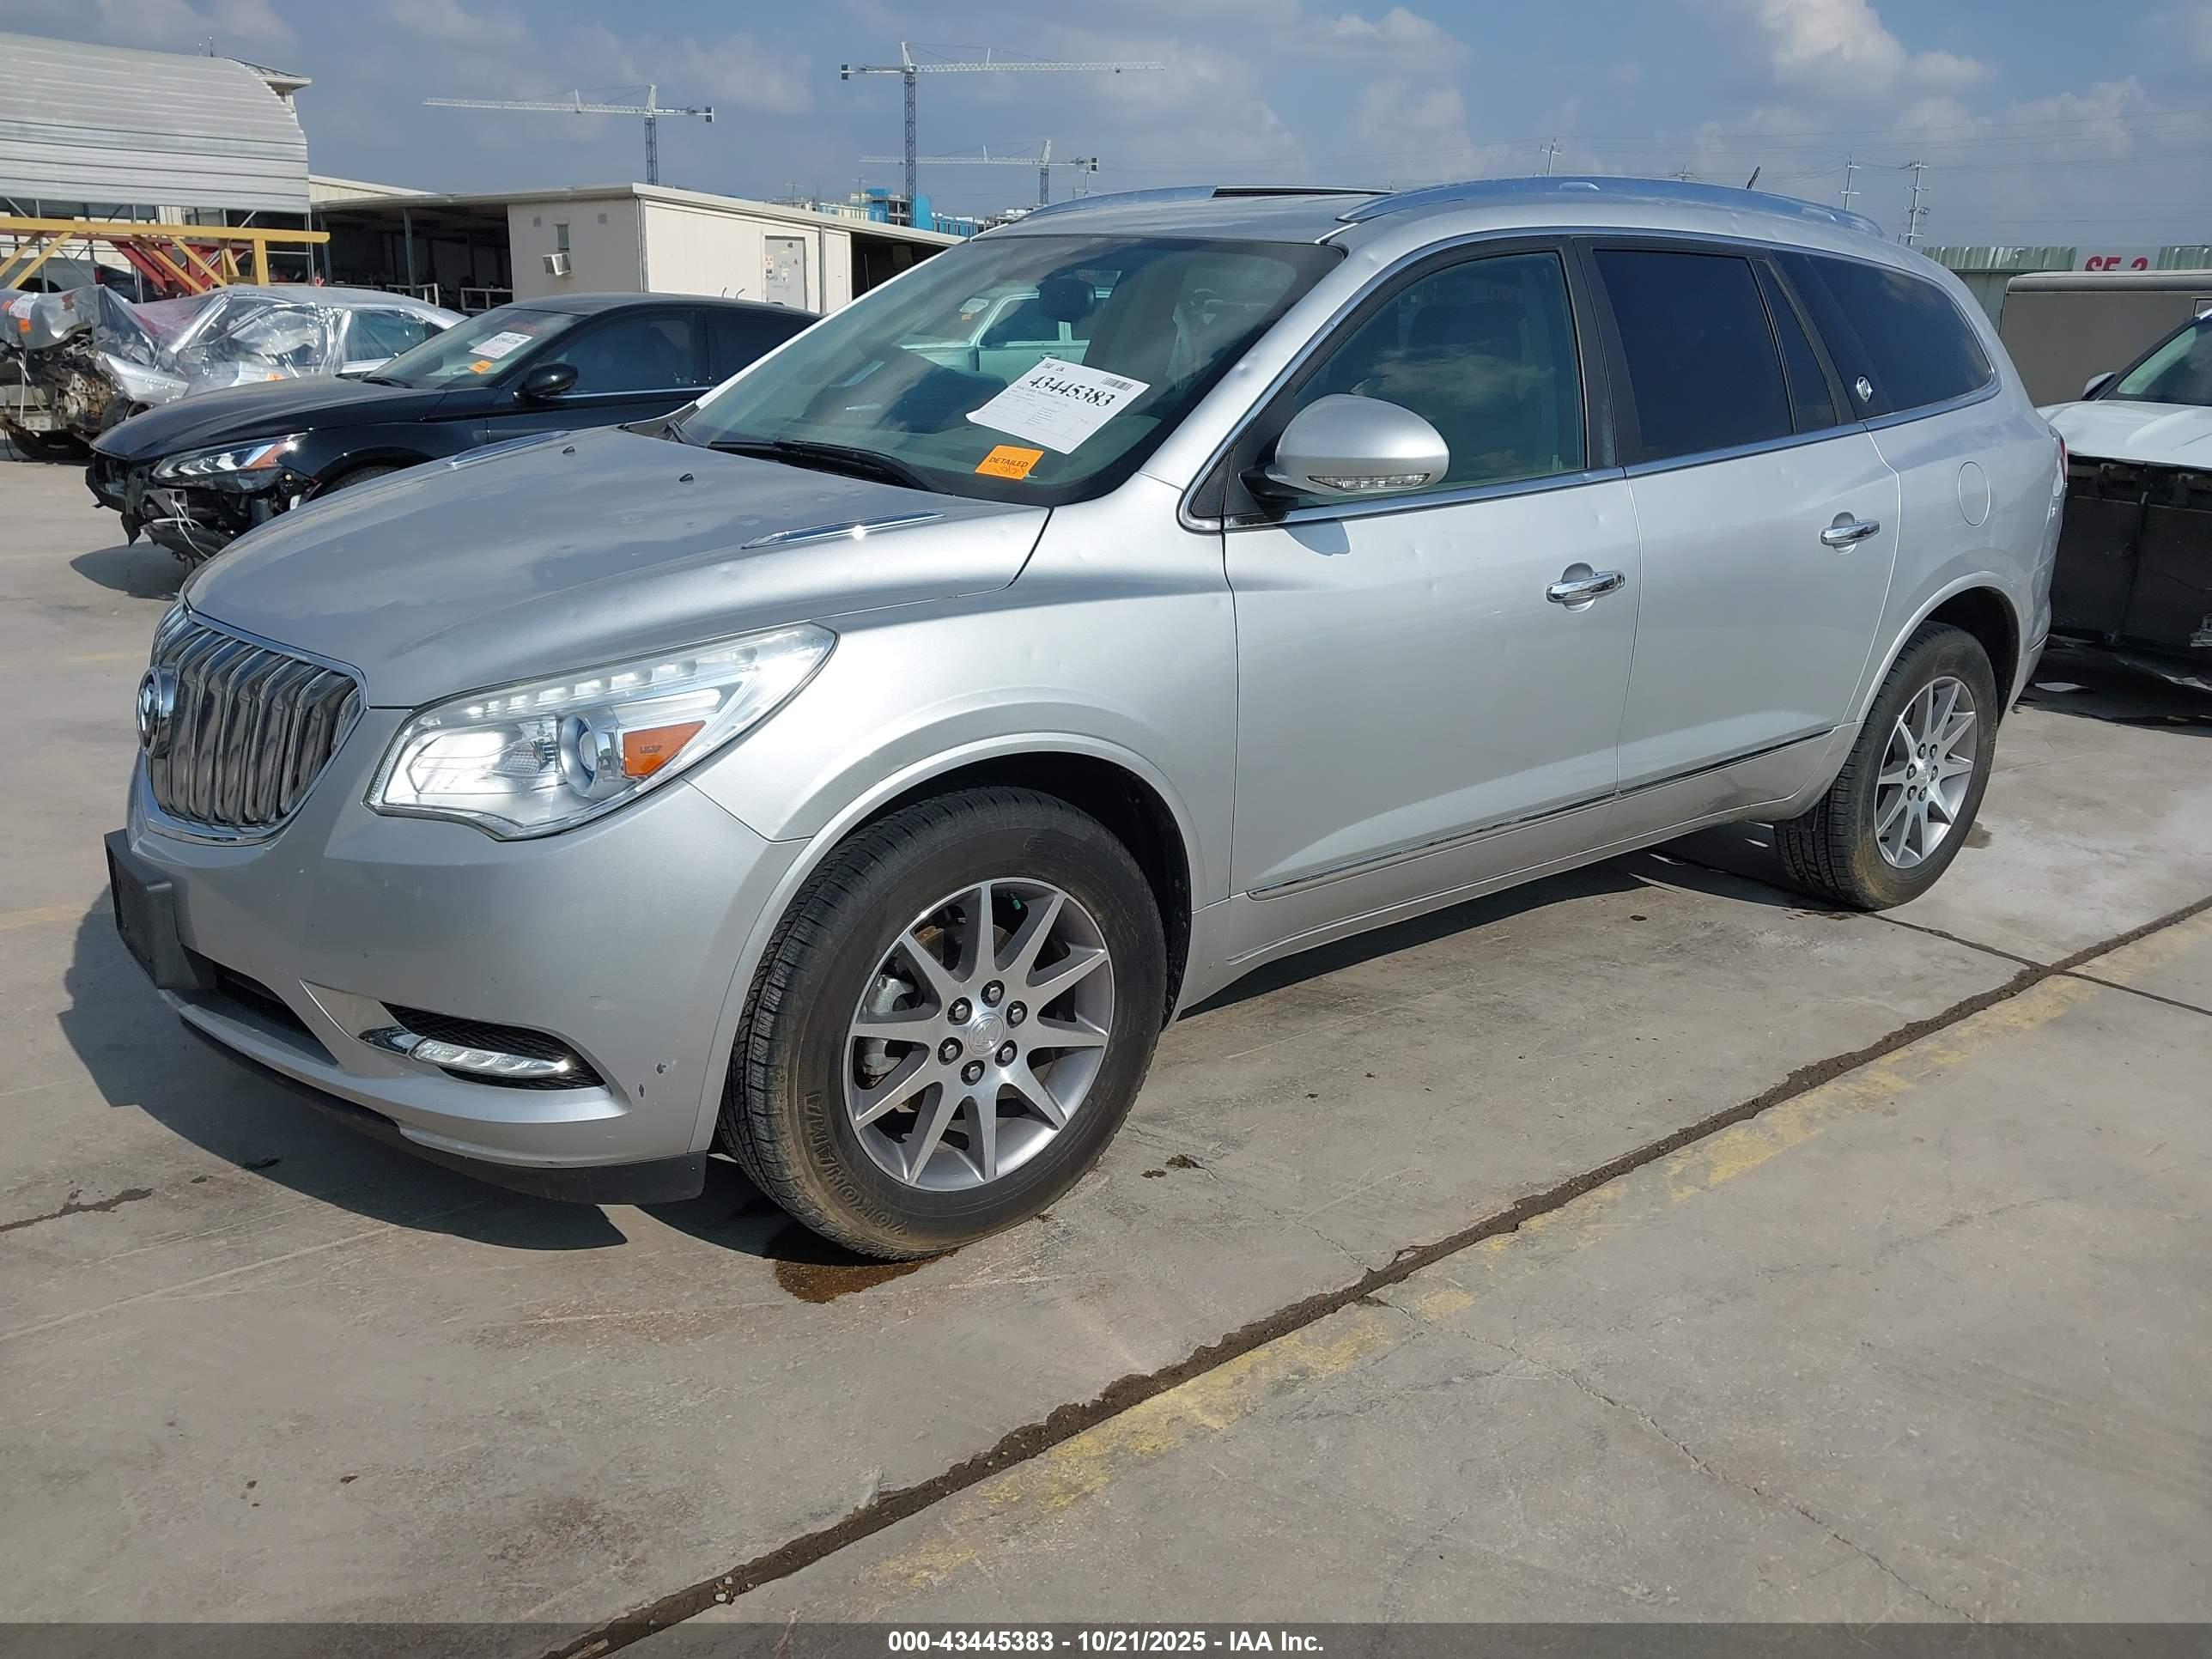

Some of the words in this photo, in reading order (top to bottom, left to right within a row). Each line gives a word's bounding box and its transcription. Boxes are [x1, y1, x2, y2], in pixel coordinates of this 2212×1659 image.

[1029, 375, 1115, 407] 43445383
[988, 457, 1030, 468] DETAILED
[804, 1092, 908, 1237] YOKOHAMA
